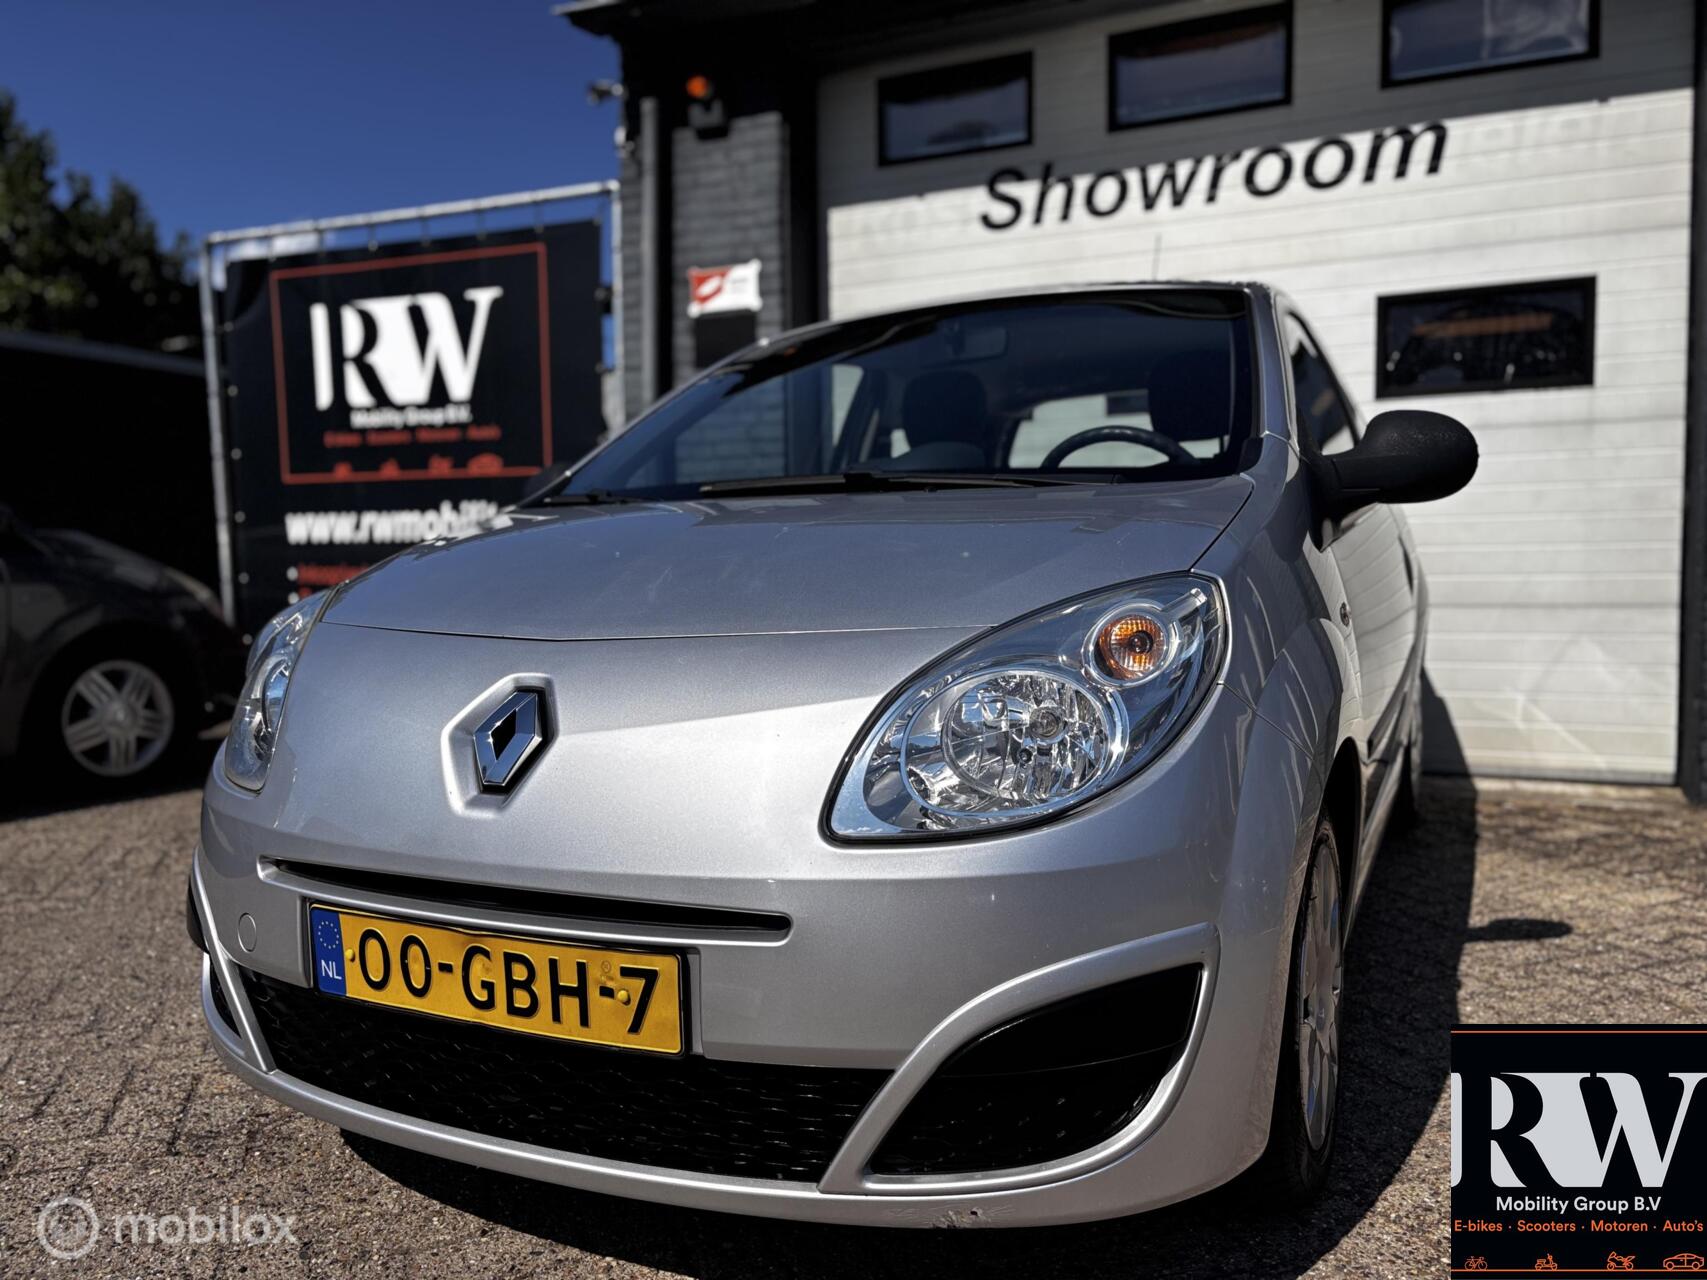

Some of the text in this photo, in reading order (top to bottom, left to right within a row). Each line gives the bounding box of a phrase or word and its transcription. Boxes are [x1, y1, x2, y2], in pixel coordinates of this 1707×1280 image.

[980, 120, 1448, 232] Showroom
[310, 286, 504, 411] RW
[320, 959, 342, 981] NL
[358, 927, 660, 1035] 00-GBH-7
